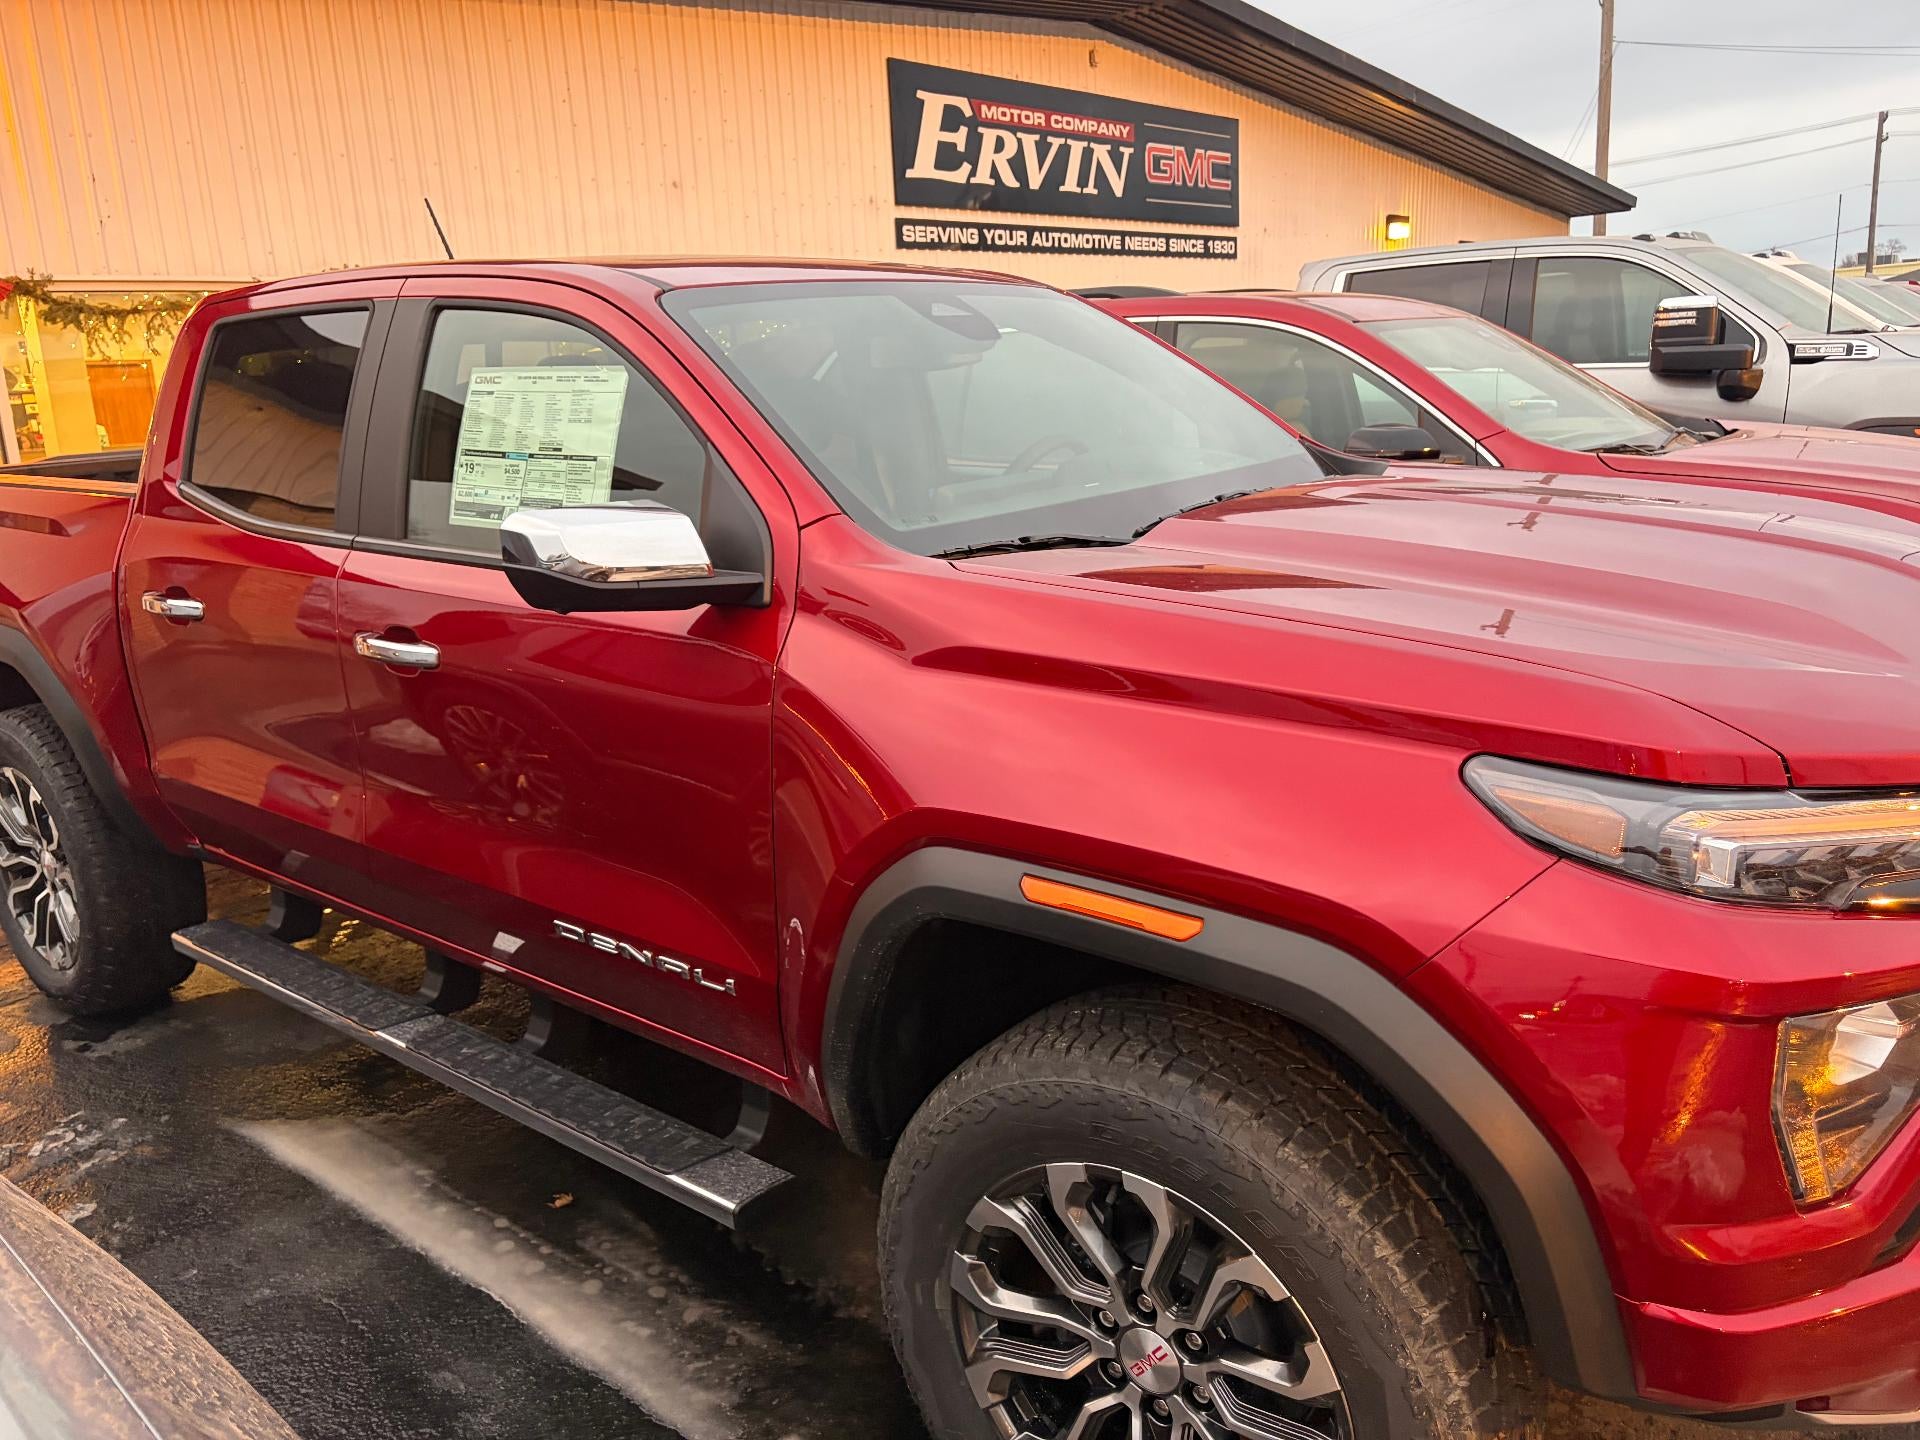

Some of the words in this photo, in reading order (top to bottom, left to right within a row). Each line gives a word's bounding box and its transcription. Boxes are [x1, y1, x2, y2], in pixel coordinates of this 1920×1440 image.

[980, 104, 1046, 127] MOTOR
[1050, 114, 1130, 139] COMPANY
[905, 90, 1134, 198] ERVIN
[1145, 142, 1232, 191] GMC
[901, 225, 979, 244] SERVING
[982, 228, 1028, 246] YOUR
[1031, 231, 1122, 249] AUTOMOTIVE
[1124, 236, 1166, 252] NEEDS
[1169, 238, 1205, 253] SINCE
[1207, 240, 1235, 254] 1930
[474, 375, 502, 385] GMC
[464, 462, 475, 474] 19
[553, 919, 737, 996] DENALI
[1088, 1119, 1319, 1282] DUELER
[1130, 1345, 1169, 1377] GMC
